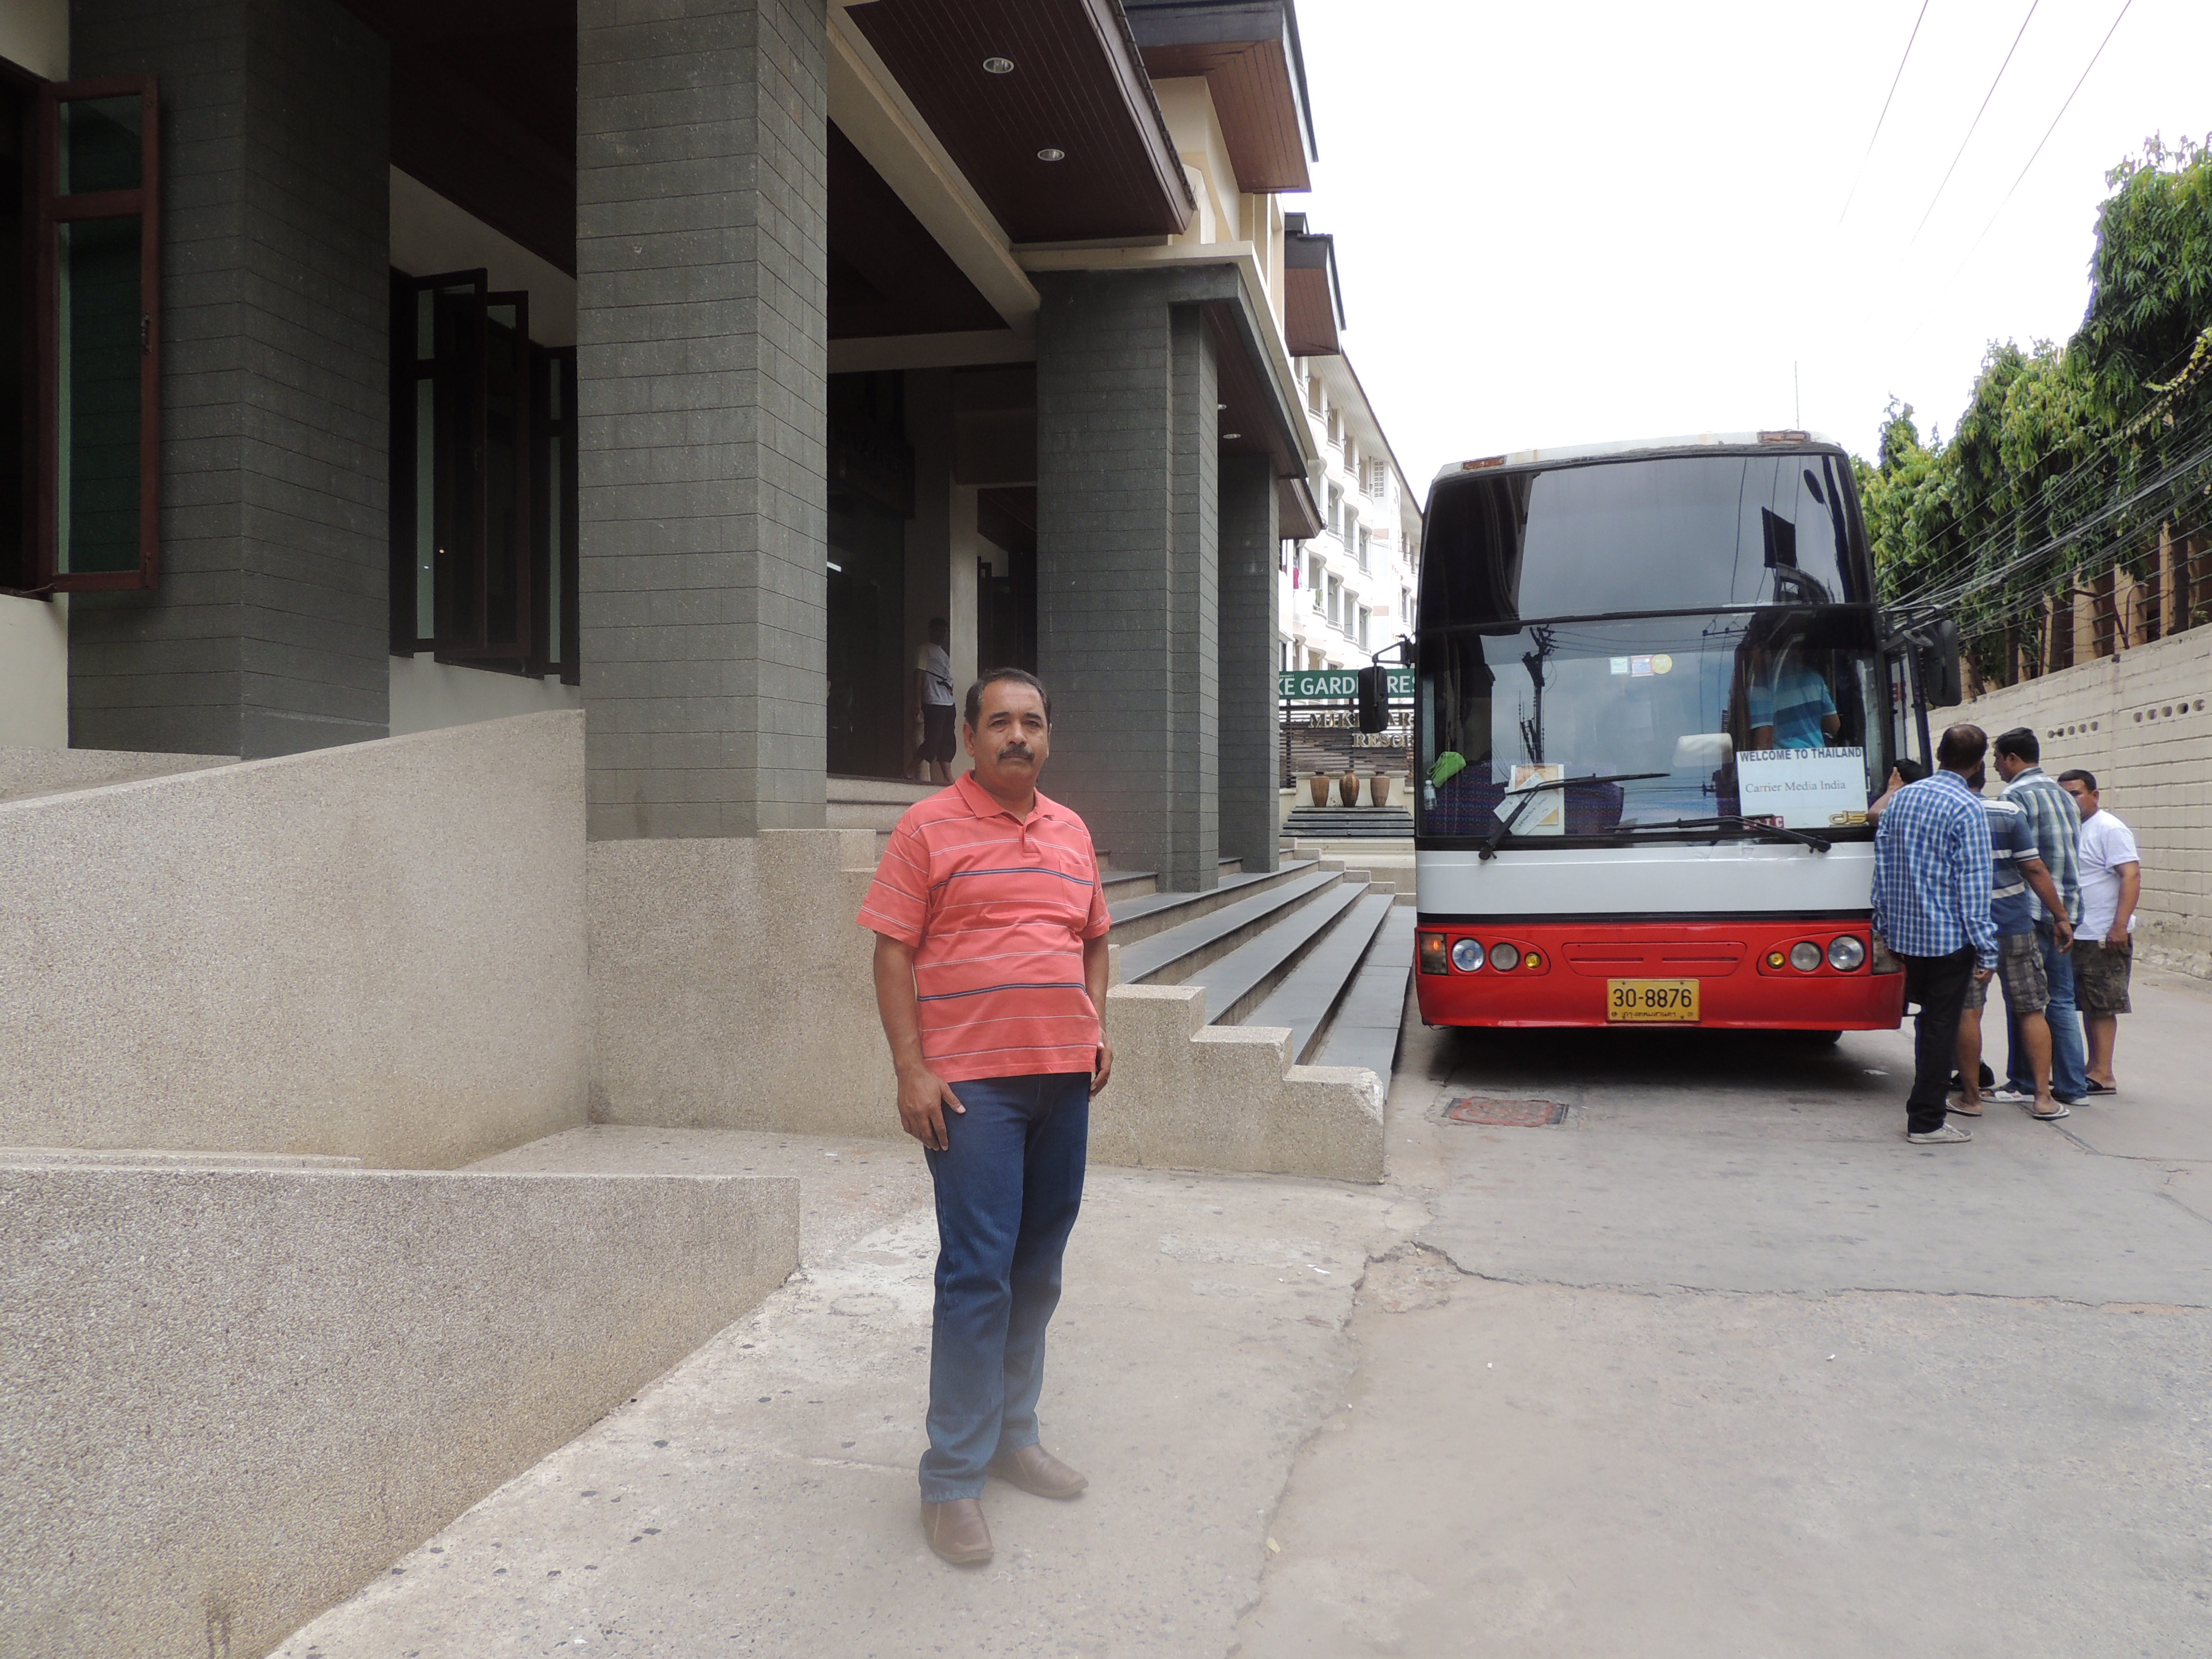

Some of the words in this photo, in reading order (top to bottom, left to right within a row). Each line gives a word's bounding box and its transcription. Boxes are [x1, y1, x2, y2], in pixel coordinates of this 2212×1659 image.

[1300, 677, 1358, 695] GARD
[1387, 675, 1415, 693] RE
[1740, 749, 1791, 762] WELCOME
[1794, 749, 1808, 759] TO
[1811, 747, 1862, 759] THAILAND
[1745, 782, 1781, 793] Carrier
[1784, 781, 1817, 791] Media
[1820, 780, 1846, 790] India
[1613, 988, 1692, 1008] 30-8876
